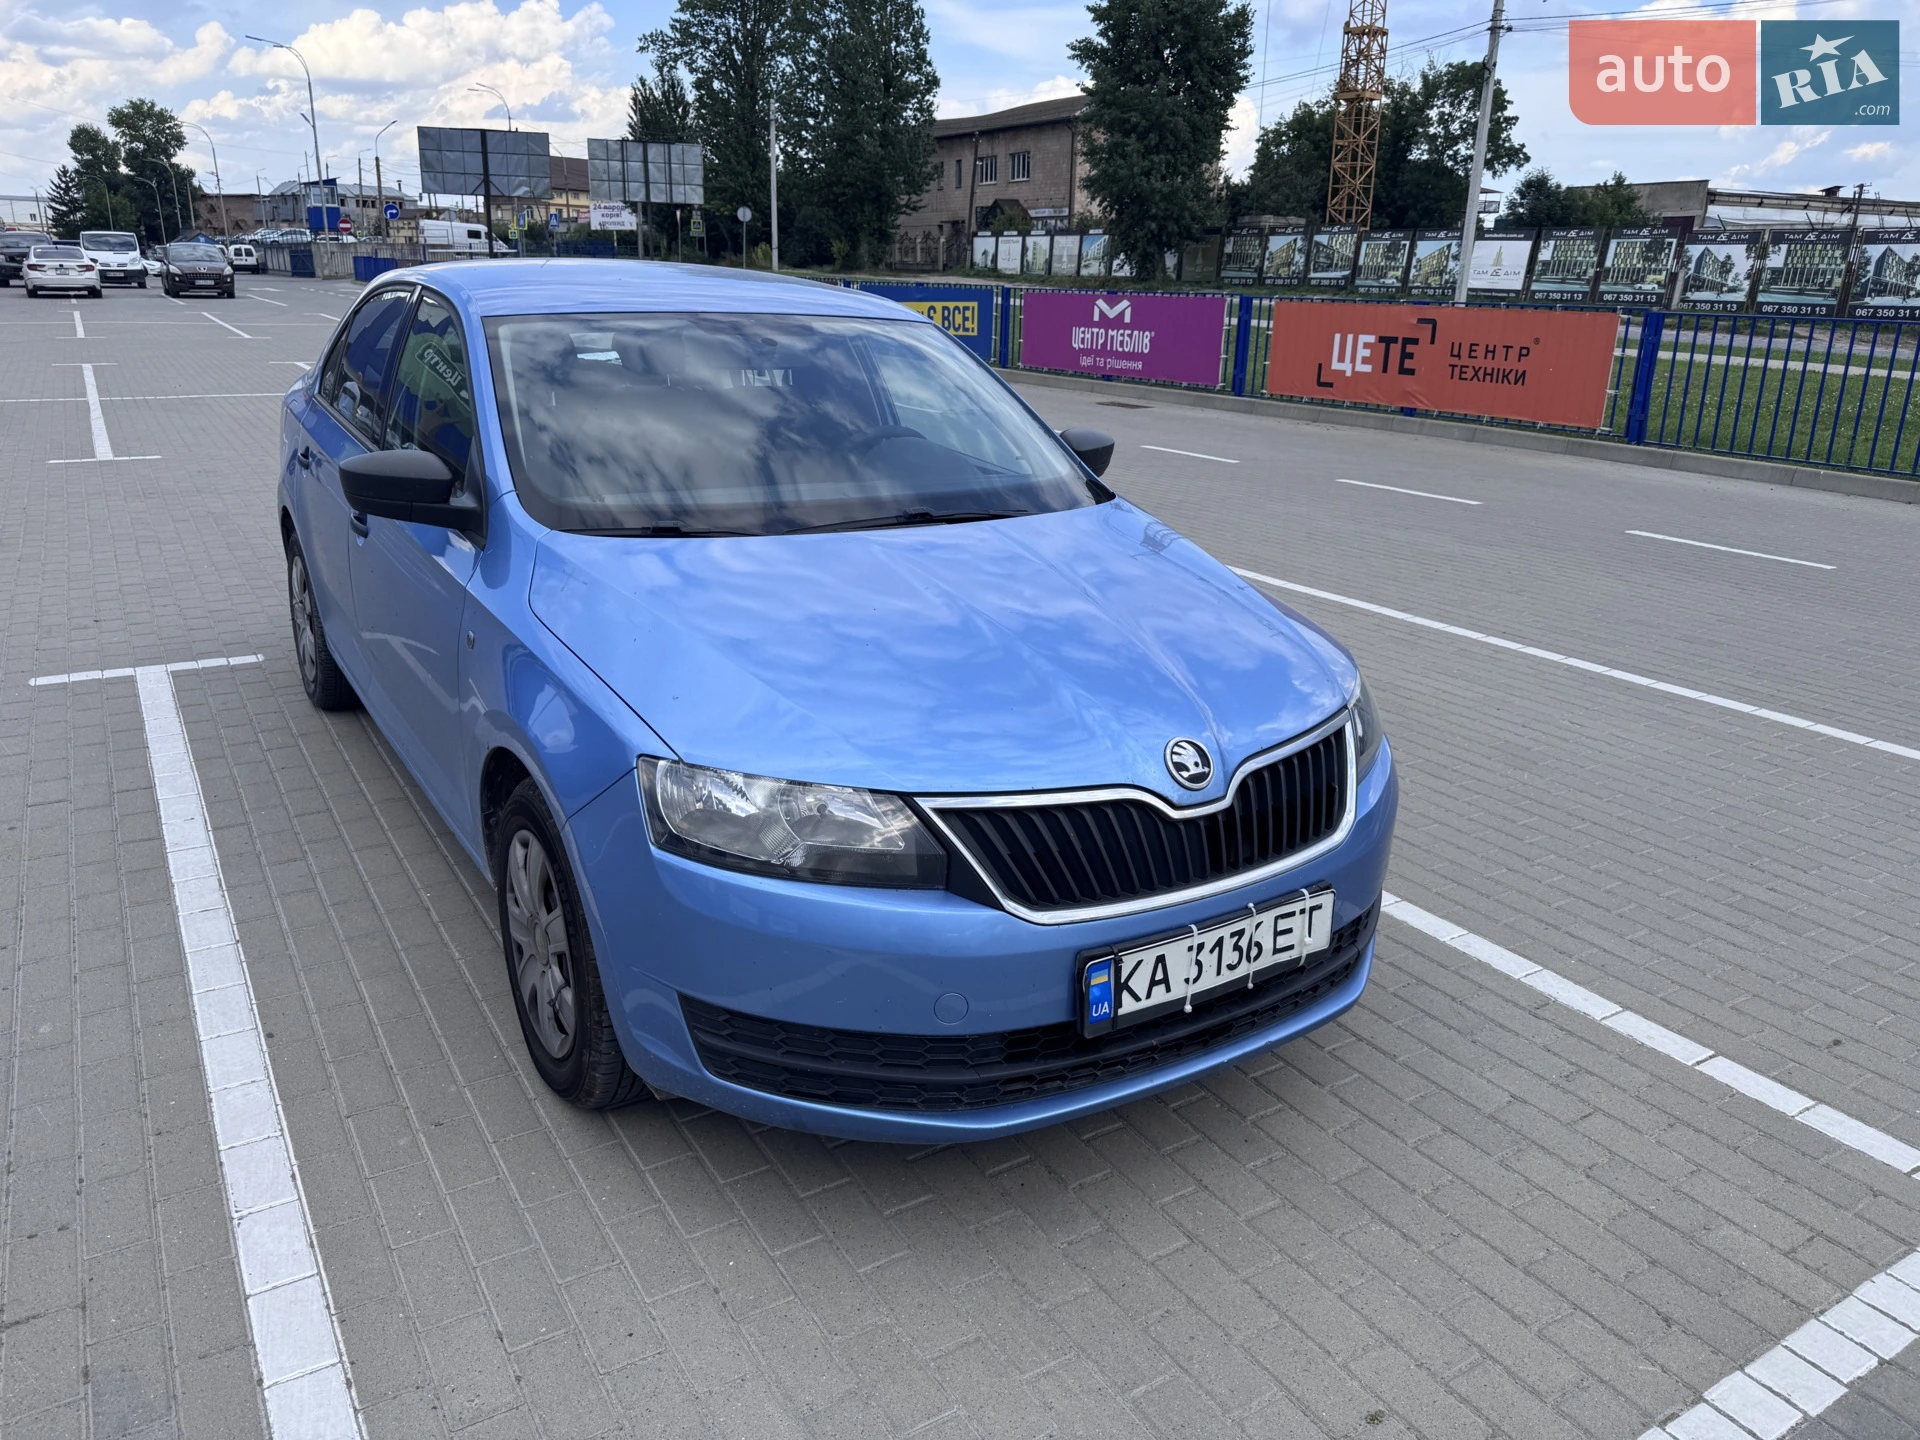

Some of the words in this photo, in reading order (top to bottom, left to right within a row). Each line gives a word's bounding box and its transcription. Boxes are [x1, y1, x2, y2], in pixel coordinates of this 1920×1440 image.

[1548, 292, 1562, 300] 350
[942, 305, 975, 333] ВСЕ!
[1800, 306, 1811, 314] 31
[1815, 307, 1826, 315] 13
[1876, 309, 1896, 317] 350
[1898, 309, 1909, 317] 31
[1071, 326, 1105, 350] ЦЕНТР
[1080, 353, 1094, 367] ідеї
[1096, 357, 1105, 366] та
[1106, 357, 1142, 371] рішення
[1330, 332, 1420, 377] ЦЕТЕ
[1449, 341, 1531, 364] ЦЕНТР
[1448, 364, 1527, 386] ТЕХНІКИ
[1119, 954, 1172, 1008] KA
[1092, 1004, 1110, 1017] UA
